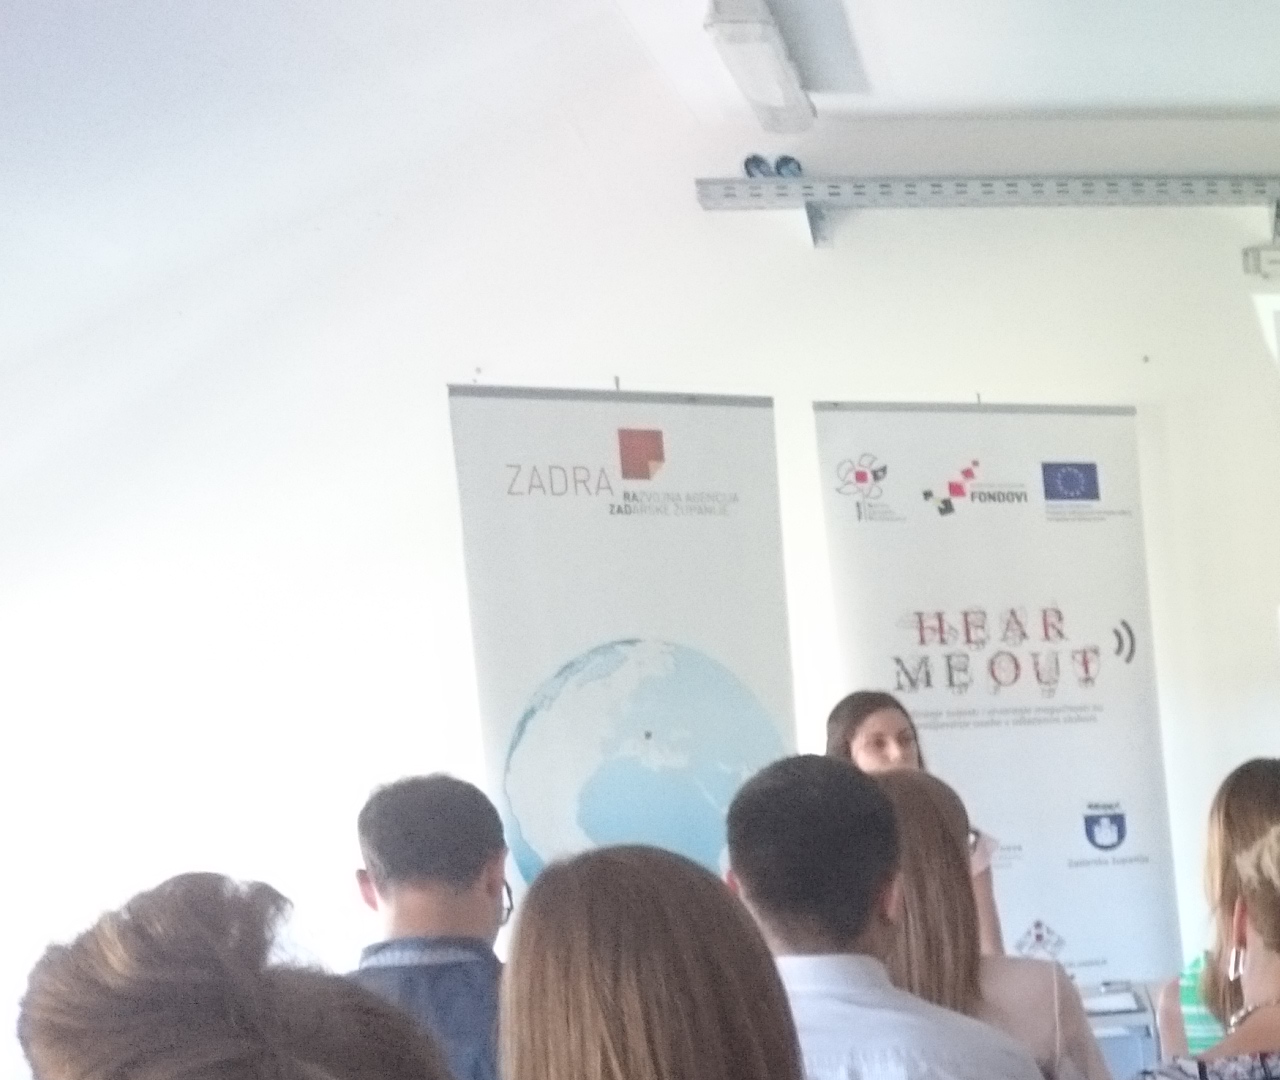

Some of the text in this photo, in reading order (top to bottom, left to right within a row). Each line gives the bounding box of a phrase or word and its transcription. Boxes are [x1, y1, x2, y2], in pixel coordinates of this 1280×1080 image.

[506, 464, 614, 496] ZADRA
[970, 490, 1028, 504] FONDOVI
[913, 607, 1067, 648] HEAR
[893, 647, 1102, 694] ME OUT
